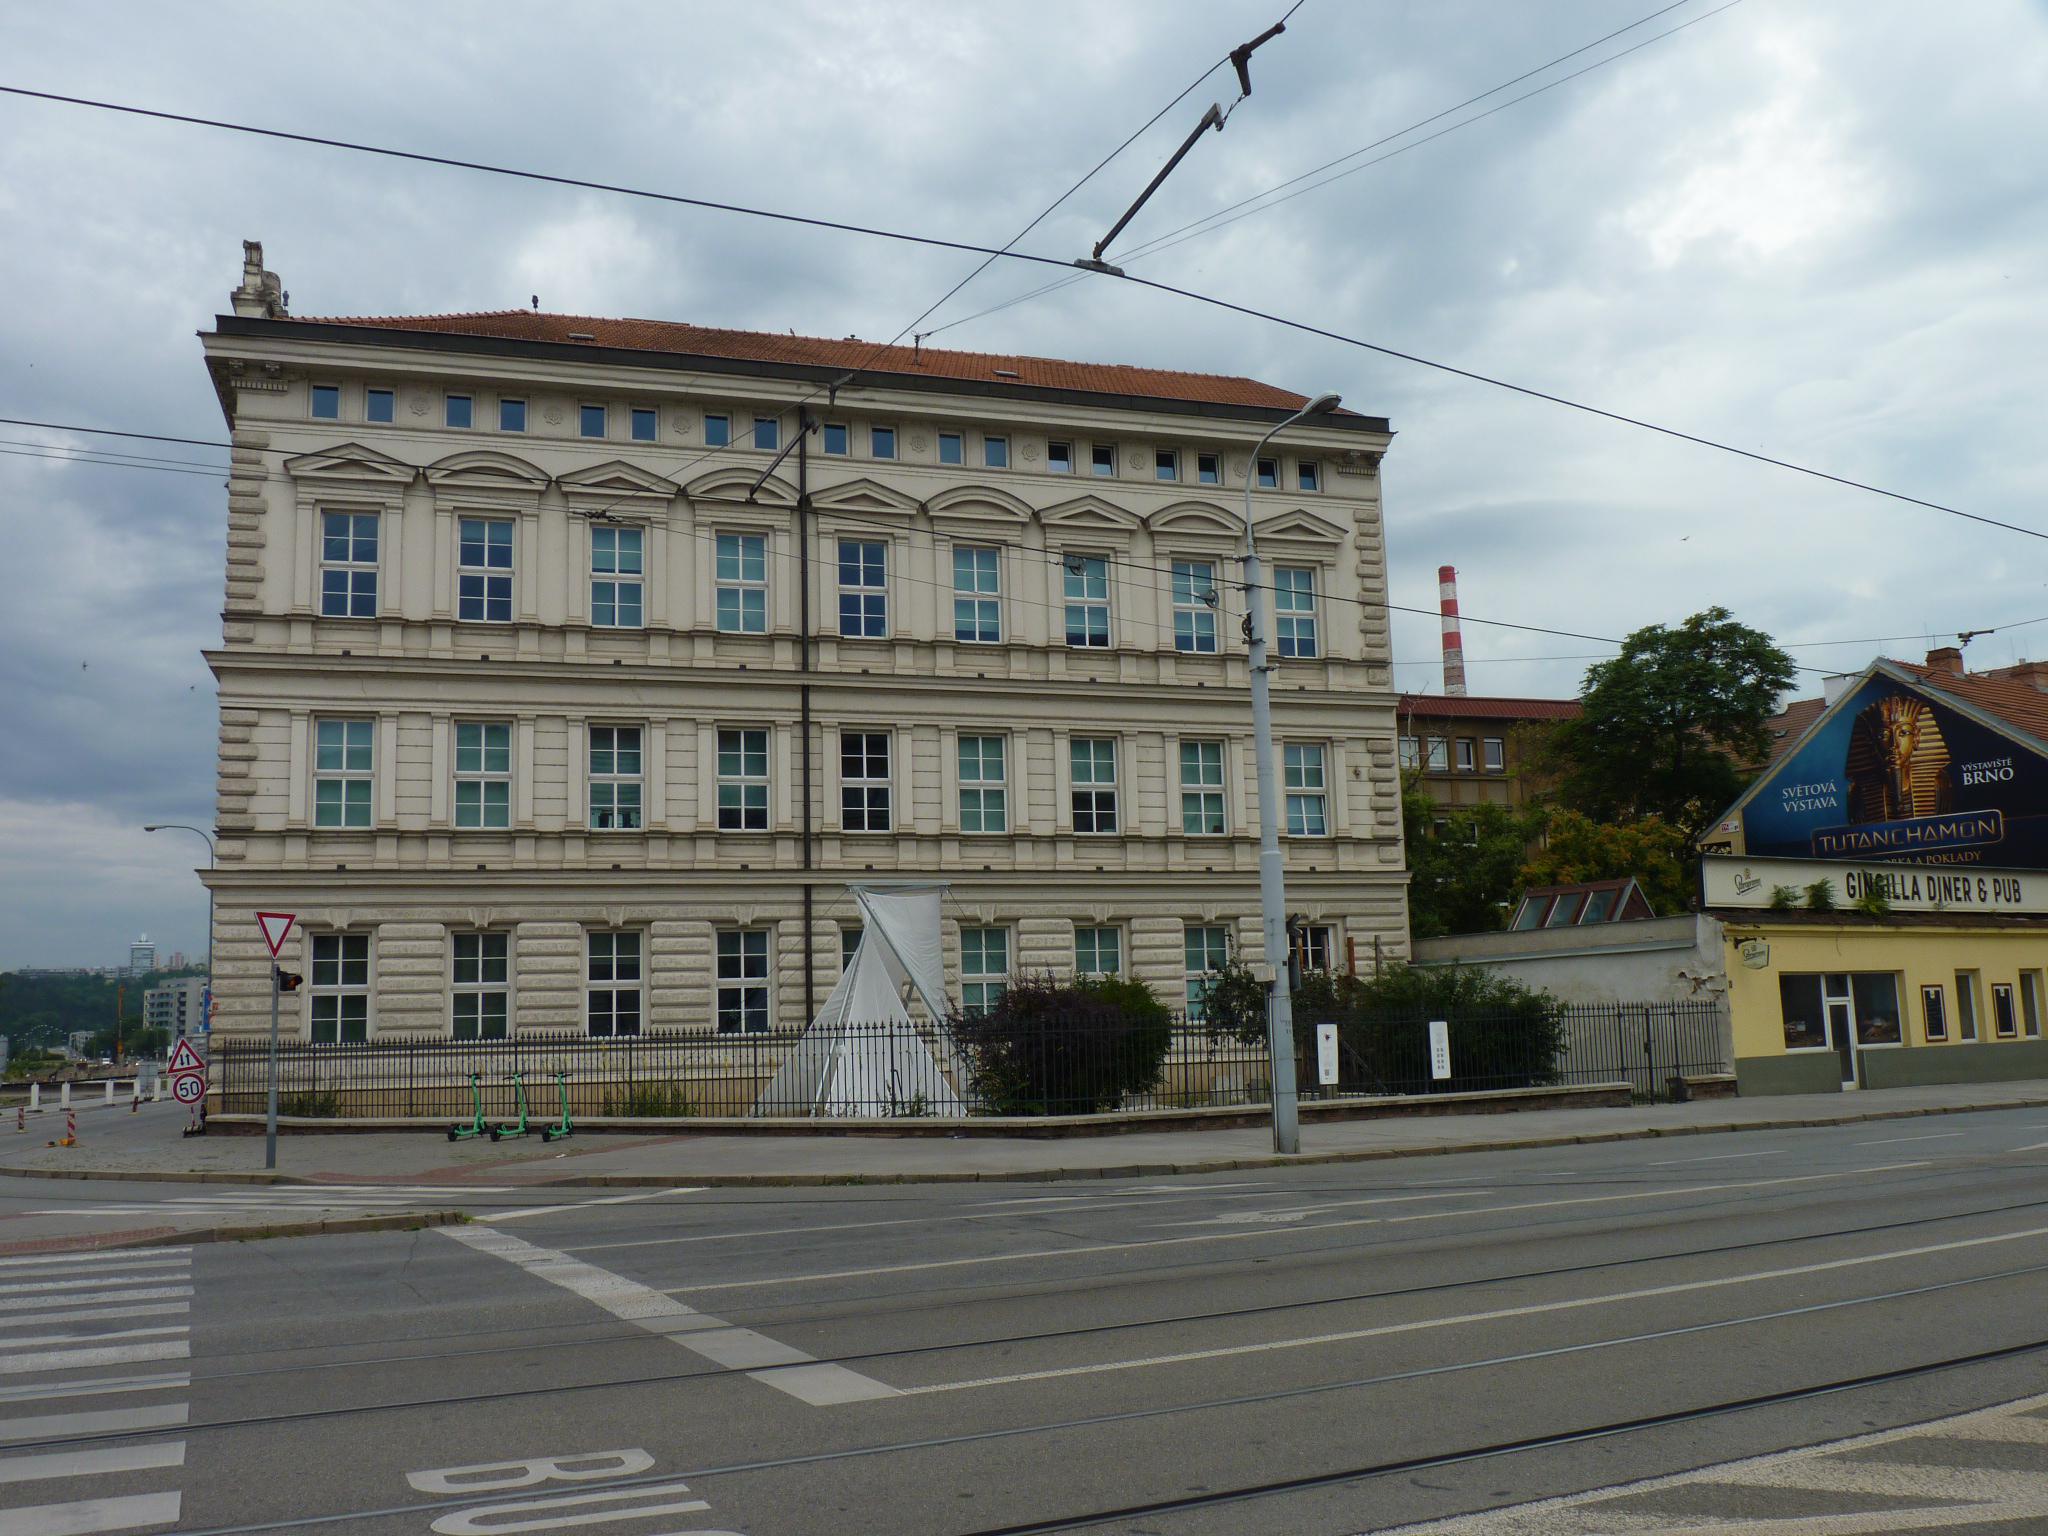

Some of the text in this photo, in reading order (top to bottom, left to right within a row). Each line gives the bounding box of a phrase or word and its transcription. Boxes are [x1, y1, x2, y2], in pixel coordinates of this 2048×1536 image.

[1963, 767, 2014, 785] BRNO
[1782, 779, 1837, 799] SVĚTOVÁ
[1783, 796, 1838, 813] VÝSTAVA
[1819, 819, 1995, 852] TUTANCHAMON
[1926, 851, 1981, 865] POKLADY
[1926, 875, 1972, 902] DINER
[1977, 877, 1987, 903] &
[1992, 878, 2022, 903] PUB
[179, 1081, 199, 1097] 50
[405, 1448, 746, 1536] BU
